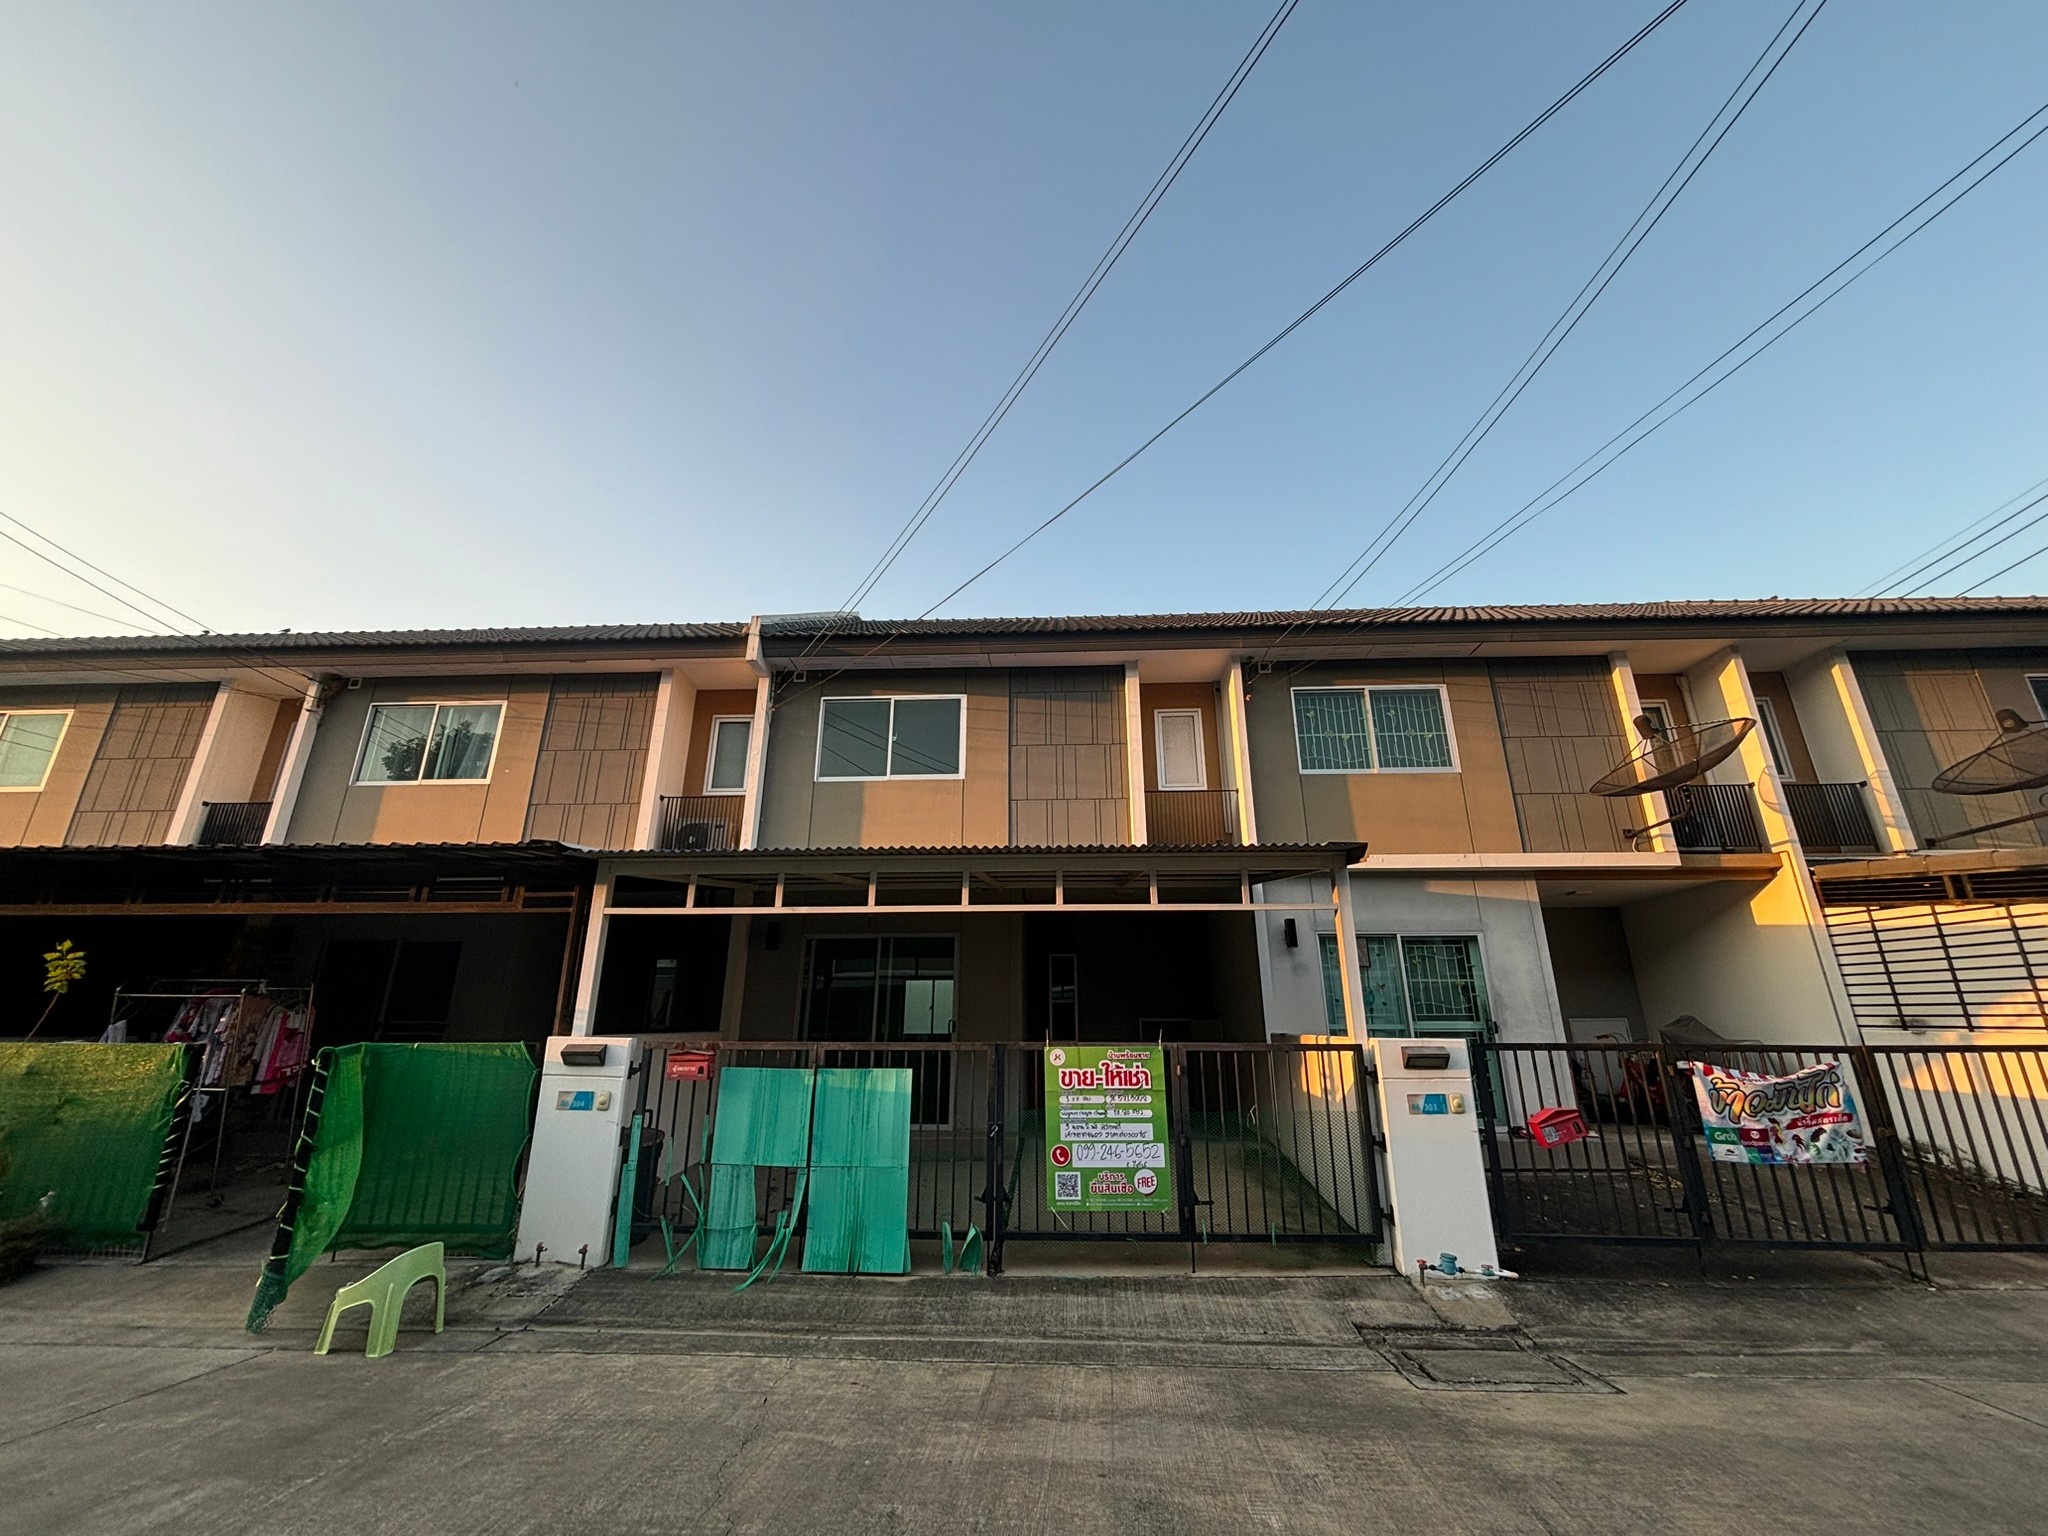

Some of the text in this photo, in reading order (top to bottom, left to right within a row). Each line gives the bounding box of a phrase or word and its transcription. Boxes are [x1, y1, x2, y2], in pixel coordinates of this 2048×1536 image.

[1060, 1061, 1150, 1087] ขาย-ให้เช่า
[1424, 1103, 1438, 1111] 303
[1076, 1142, 1161, 1161] 099-246-5652
[1098, 1172, 1125, 1182] บริการ
[1137, 1176, 1155, 1189] FREE
